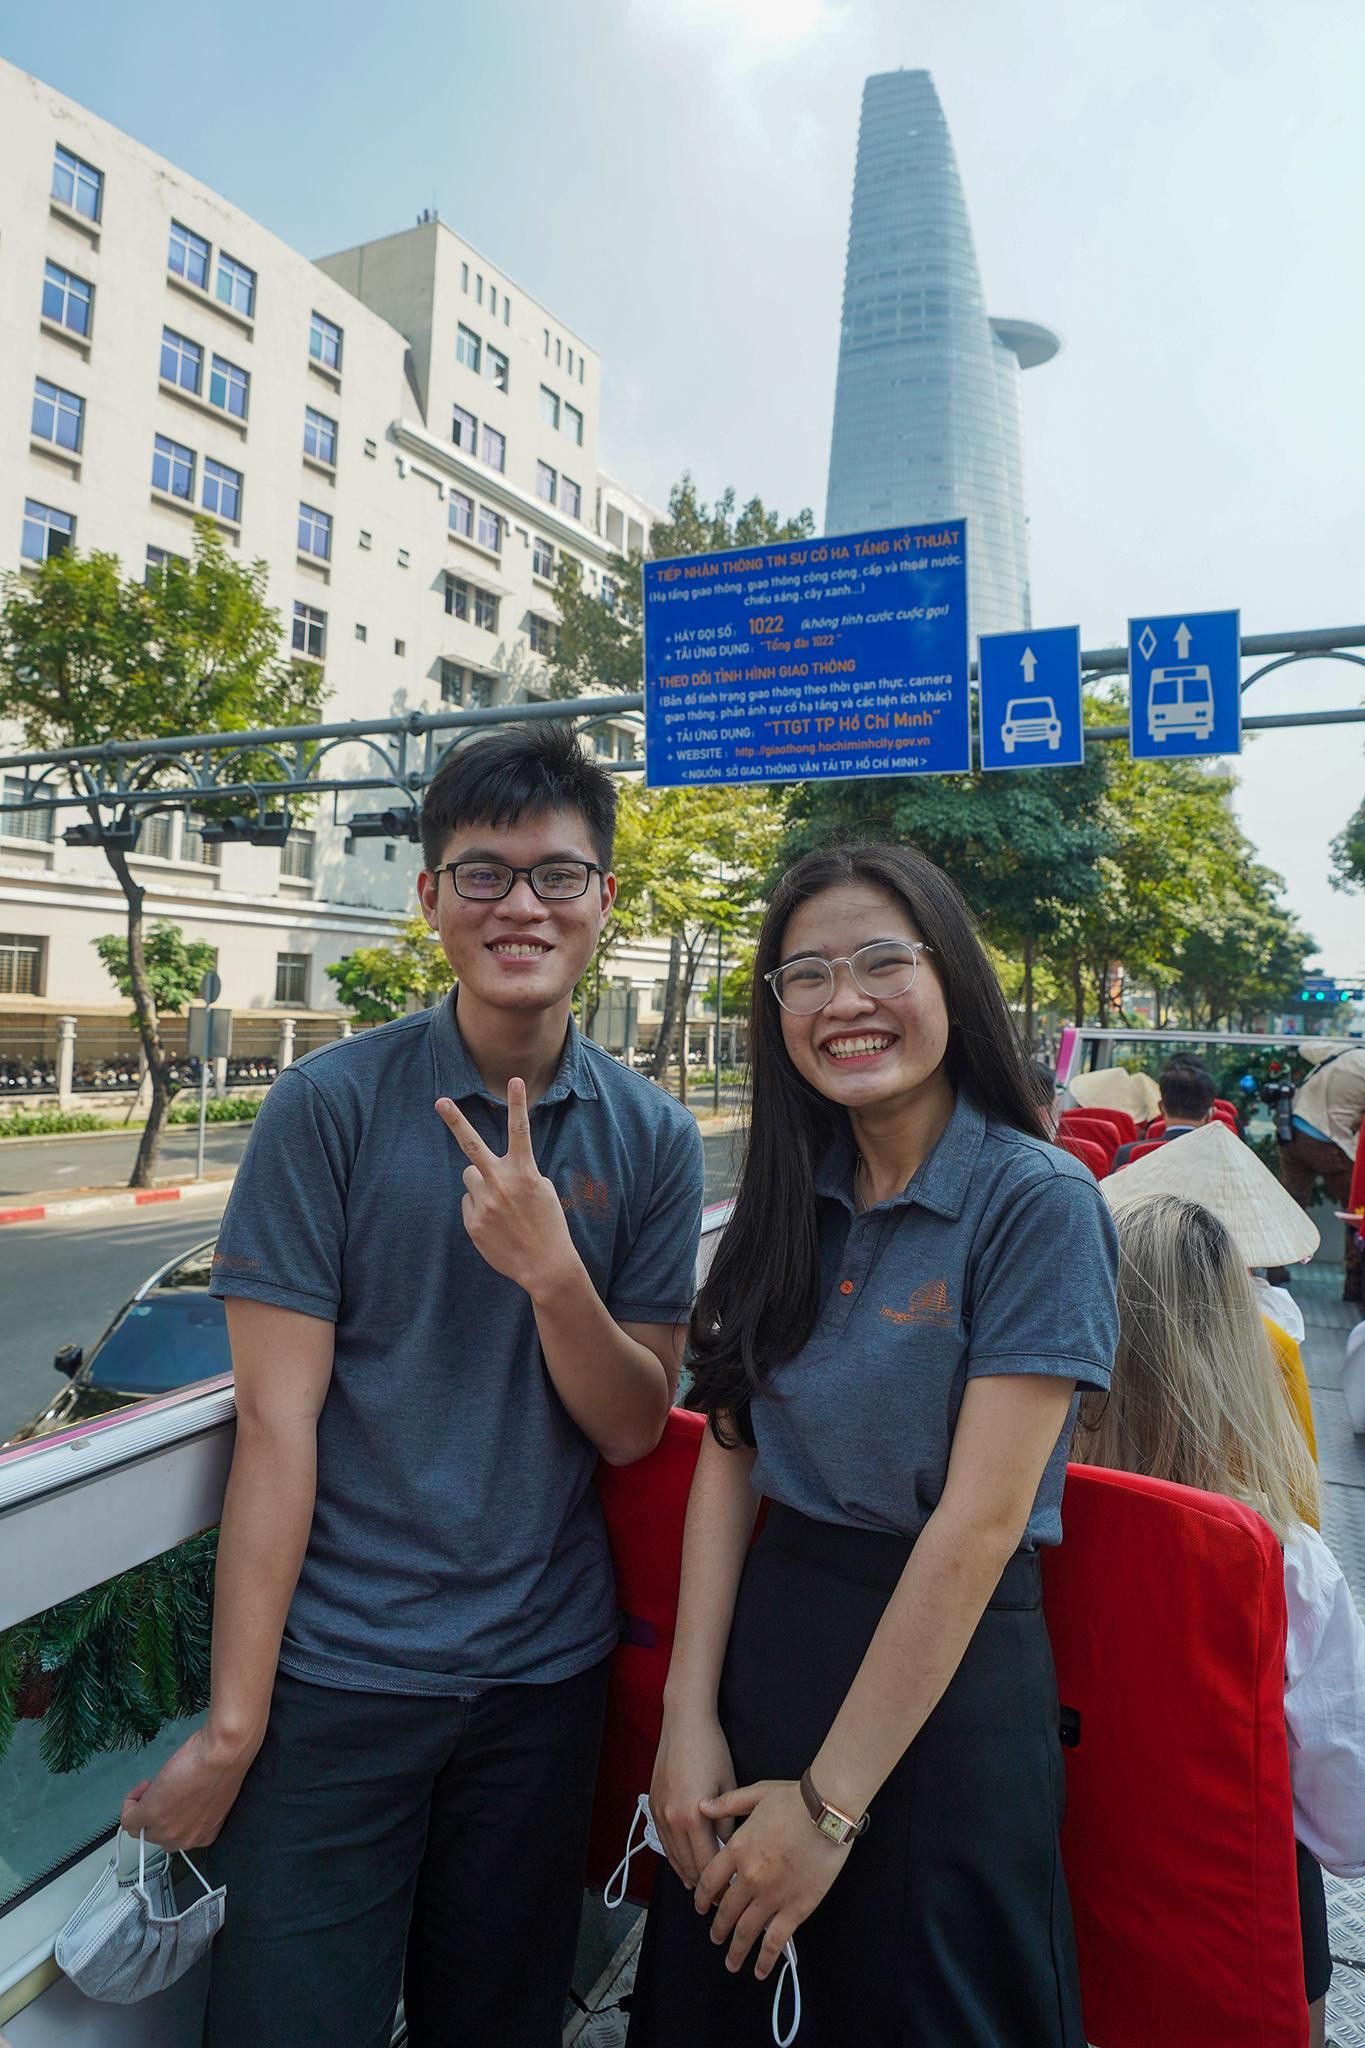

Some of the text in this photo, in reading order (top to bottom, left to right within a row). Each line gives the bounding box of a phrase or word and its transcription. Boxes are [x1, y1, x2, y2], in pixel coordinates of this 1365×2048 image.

[657, 566, 681, 583] TIẾP
[684, 563, 719, 580] NHẬN
[722, 558, 763, 574] THÔNG
[767, 554, 786, 567] TIN
[790, 550, 808, 566] SỰ
[810, 544, 828, 562] CỐ
[831, 546, 849, 562] HẠ
[893, 535, 911, 552] KỸ
[914, 530, 960, 549] THUẬT
[649, 592, 666, 604] (Hạ
[690, 586, 712, 598] giao
[747, 580, 769, 592] giao
[771, 574, 800, 587] thông
[802, 571, 829, 583] công
[862, 561, 882, 577] cấp
[884, 562, 898, 574] và
[899, 557, 928, 571] thoát
[743, 591, 771, 606] chiếu
[804, 587, 822, 600] cây
[674, 628, 696, 643] HÃY
[697, 628, 715, 641] GỌI
[749, 615, 785, 635] 1022
[801, 616, 839, 630] (không
[841, 614, 864, 626] tính
[865, 609, 894, 623] cước
[896, 607, 925, 621] cuộc
[675, 646, 692, 661] TẢI
[693, 645, 717, 660] ỨNG
[659, 674, 689, 689] THEO
[713, 667, 743, 683] TÌNH
[745, 665, 776, 681] HÌNH
[779, 663, 809, 678] GIAO
[812, 657, 856, 675] THÔNG
[719, 691, 746, 704] trạng
[748, 689, 770, 702] giao
[772, 685, 802, 699] thông
[804, 683, 828, 695] theo
[830, 680, 851, 693] thời
[853, 680, 876, 696] gian
[909, 674, 953, 688] camera
[664, 711, 686, 725] giao
[720, 705, 746, 720] phản
[748, 703, 766, 716] ánh
[769, 705, 782, 716] sự
[784, 700, 798, 713] cố
[800, 702, 814, 714] hạ
[841, 698, 854, 709] và
[856, 695, 875, 708] các
[876, 693, 898, 708] tiện
[900, 691, 917, 704] ích
[919, 689, 952, 703] khác)
[676, 728, 692, 743] TẢI
[694, 728, 718, 742] ỨNG
[814, 717, 835, 733] TP
[839, 713, 861, 731] Hồ
[864, 712, 889, 730] Chí
[726, 763, 739, 777] SỞ
[740, 766, 762, 776] GIAO
[765, 762, 797, 774] THÔNG
[799, 760, 819, 775] VẬN
[822, 758, 838, 771] TẢI
[872, 755, 889, 768] CHÍ
